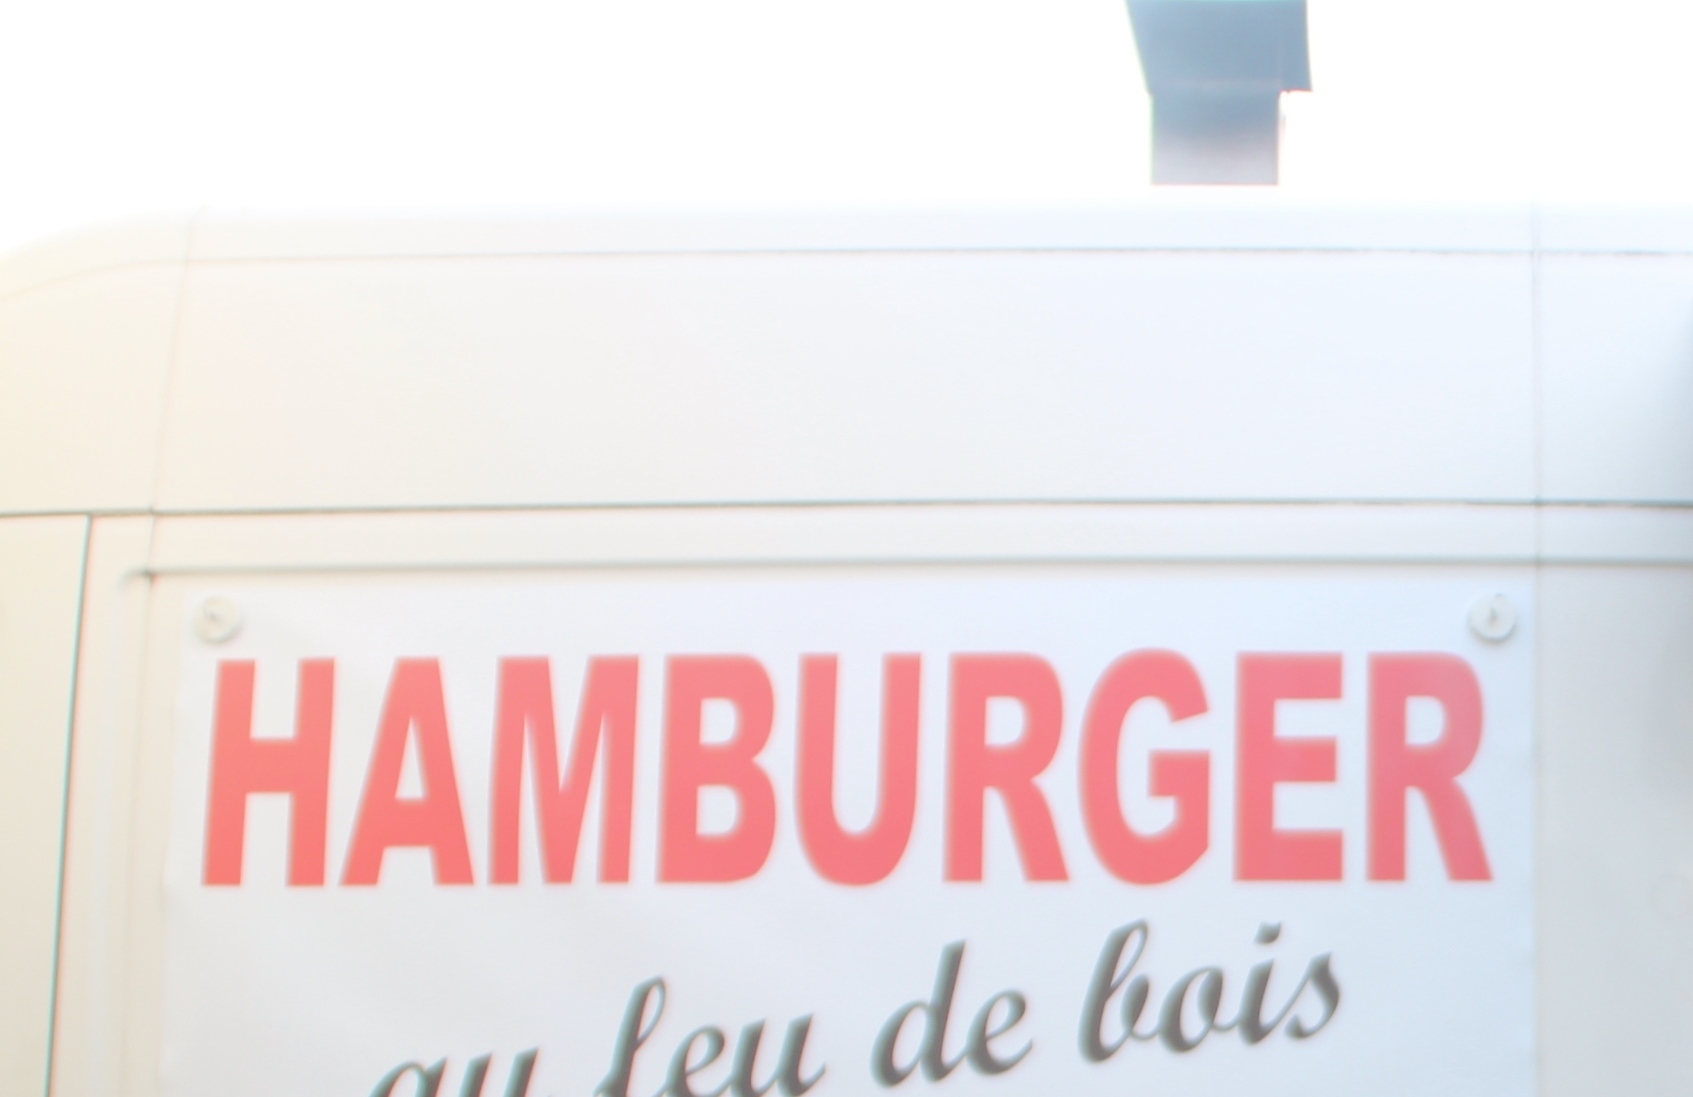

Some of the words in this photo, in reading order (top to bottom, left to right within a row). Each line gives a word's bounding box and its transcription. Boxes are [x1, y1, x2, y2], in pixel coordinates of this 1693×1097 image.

[202, 648, 1493, 888] HAMBURGER
[869, 938, 1034, 1090] de
[1077, 919, 1343, 1066] bois
